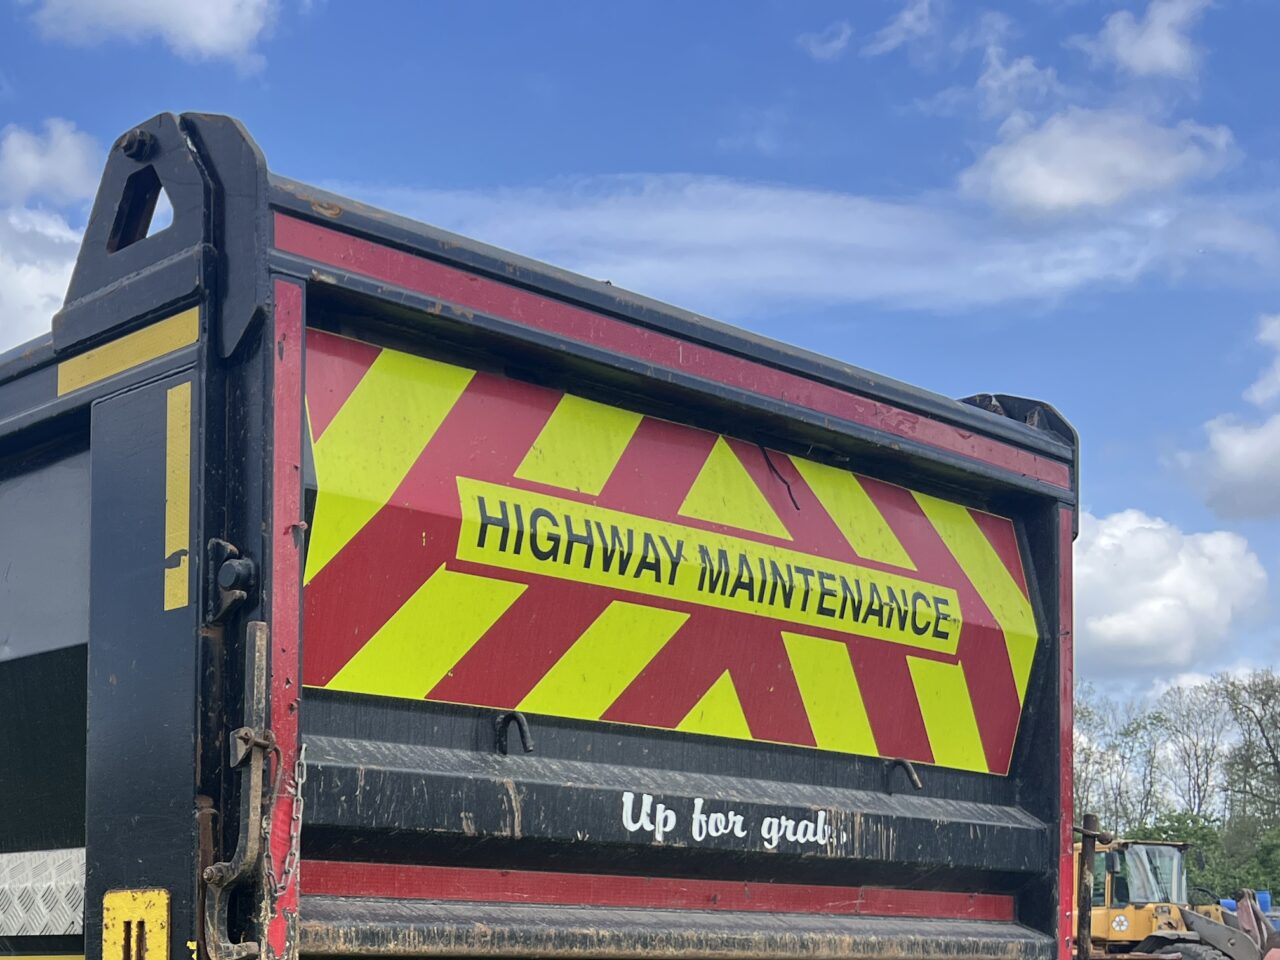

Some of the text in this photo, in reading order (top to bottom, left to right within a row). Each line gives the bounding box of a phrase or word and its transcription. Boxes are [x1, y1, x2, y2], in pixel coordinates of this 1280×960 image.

[476, 495, 952, 641] HIGHWAY MAINTENANCE
[622, 791, 677, 842] Up
[691, 797, 748, 842] for
